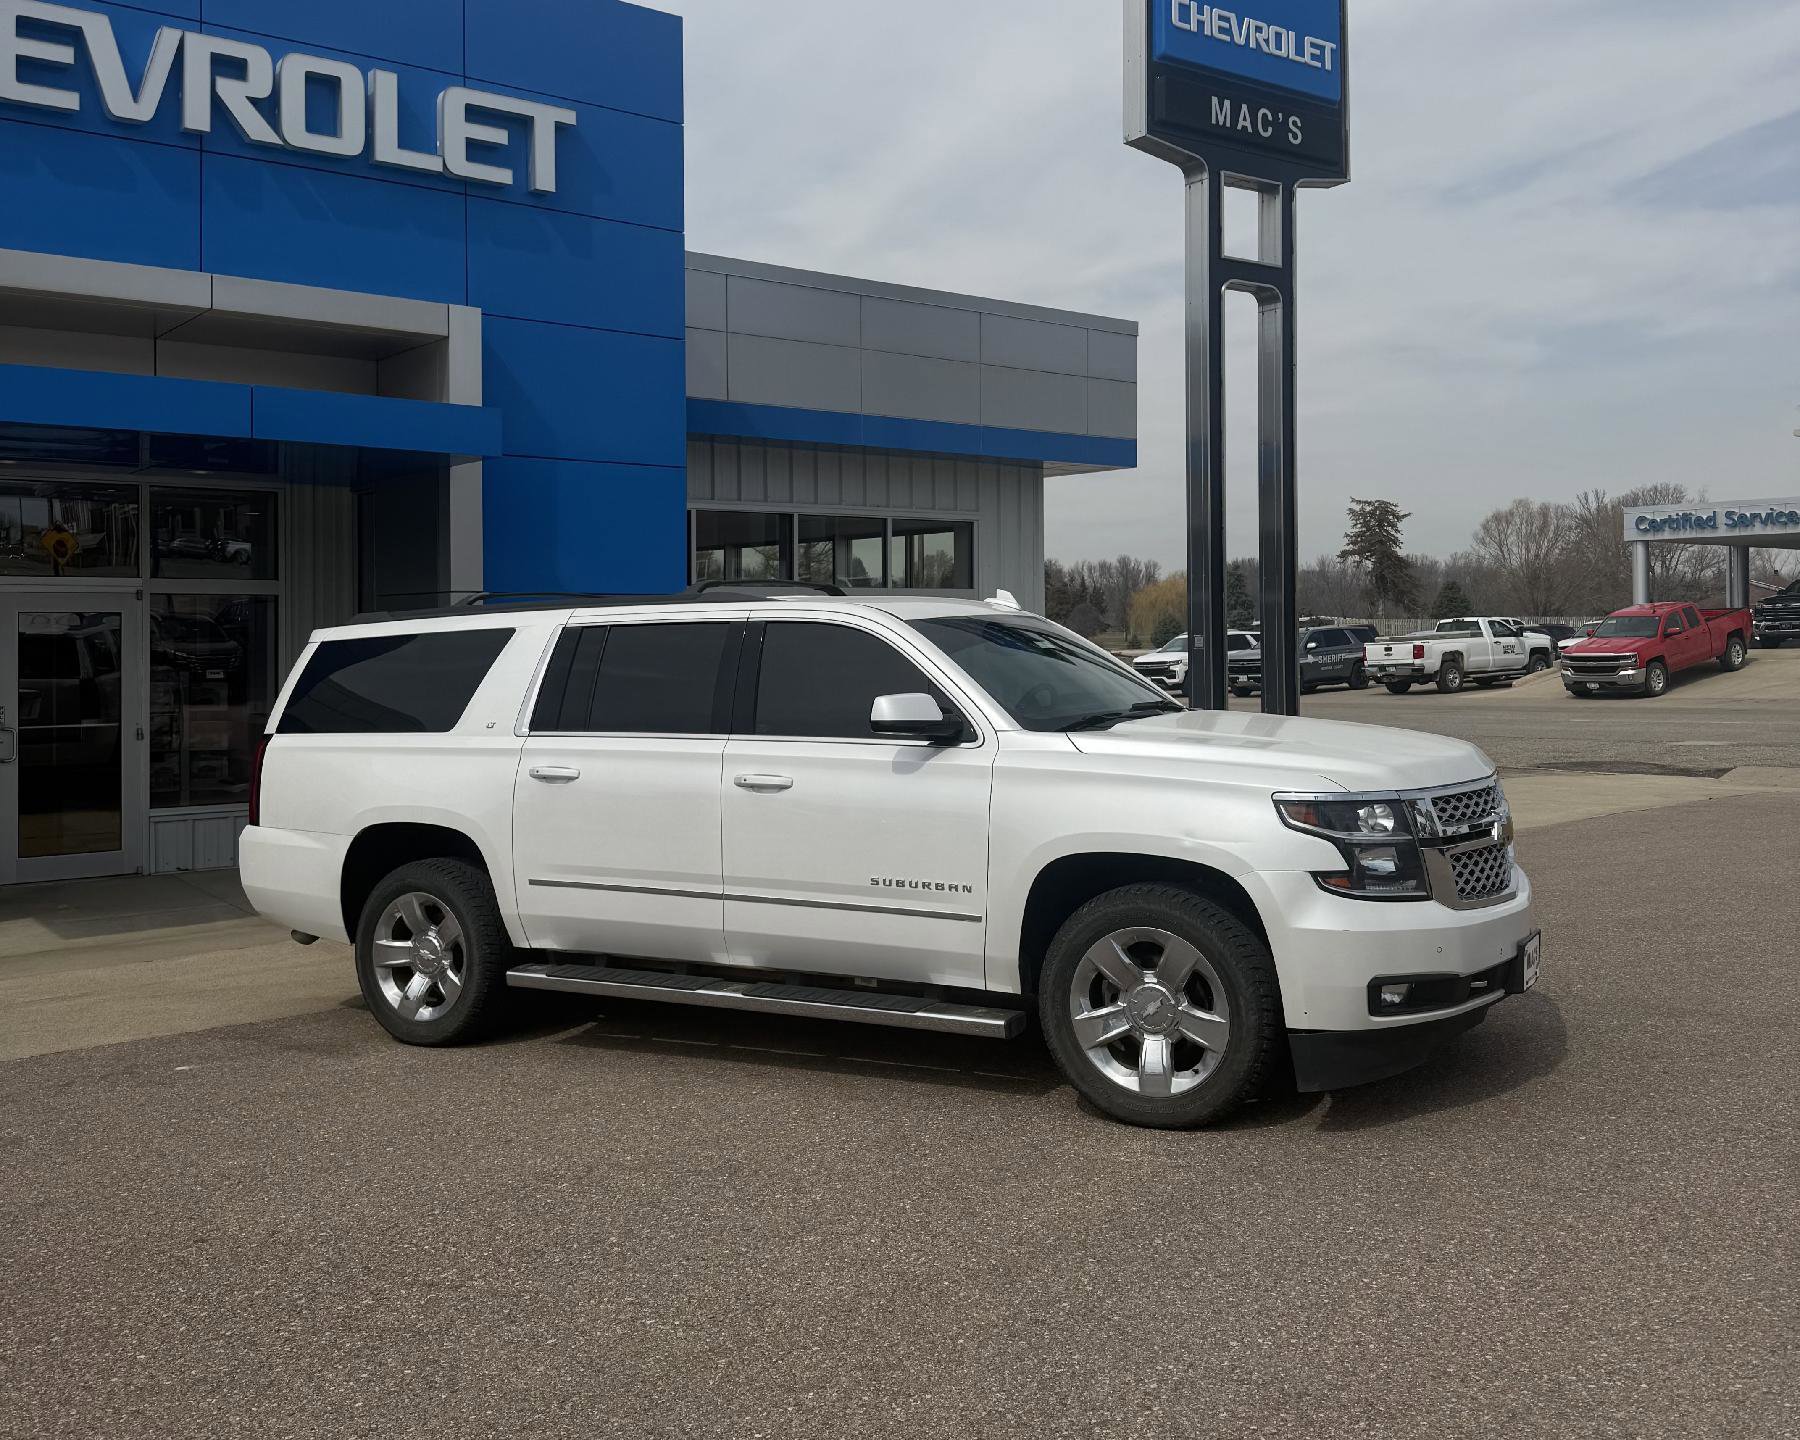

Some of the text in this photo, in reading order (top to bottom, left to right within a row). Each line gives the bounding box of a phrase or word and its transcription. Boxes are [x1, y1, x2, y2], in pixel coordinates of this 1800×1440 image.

[1171, 0, 1336, 71] CHEVROLET
[1211, 96, 1302, 145] MAC'S
[1635, 507, 1800, 533] Certified Service
[1318, 653, 1345, 664] SHERIFF
[870, 877, 972, 893] SUBURBAN
